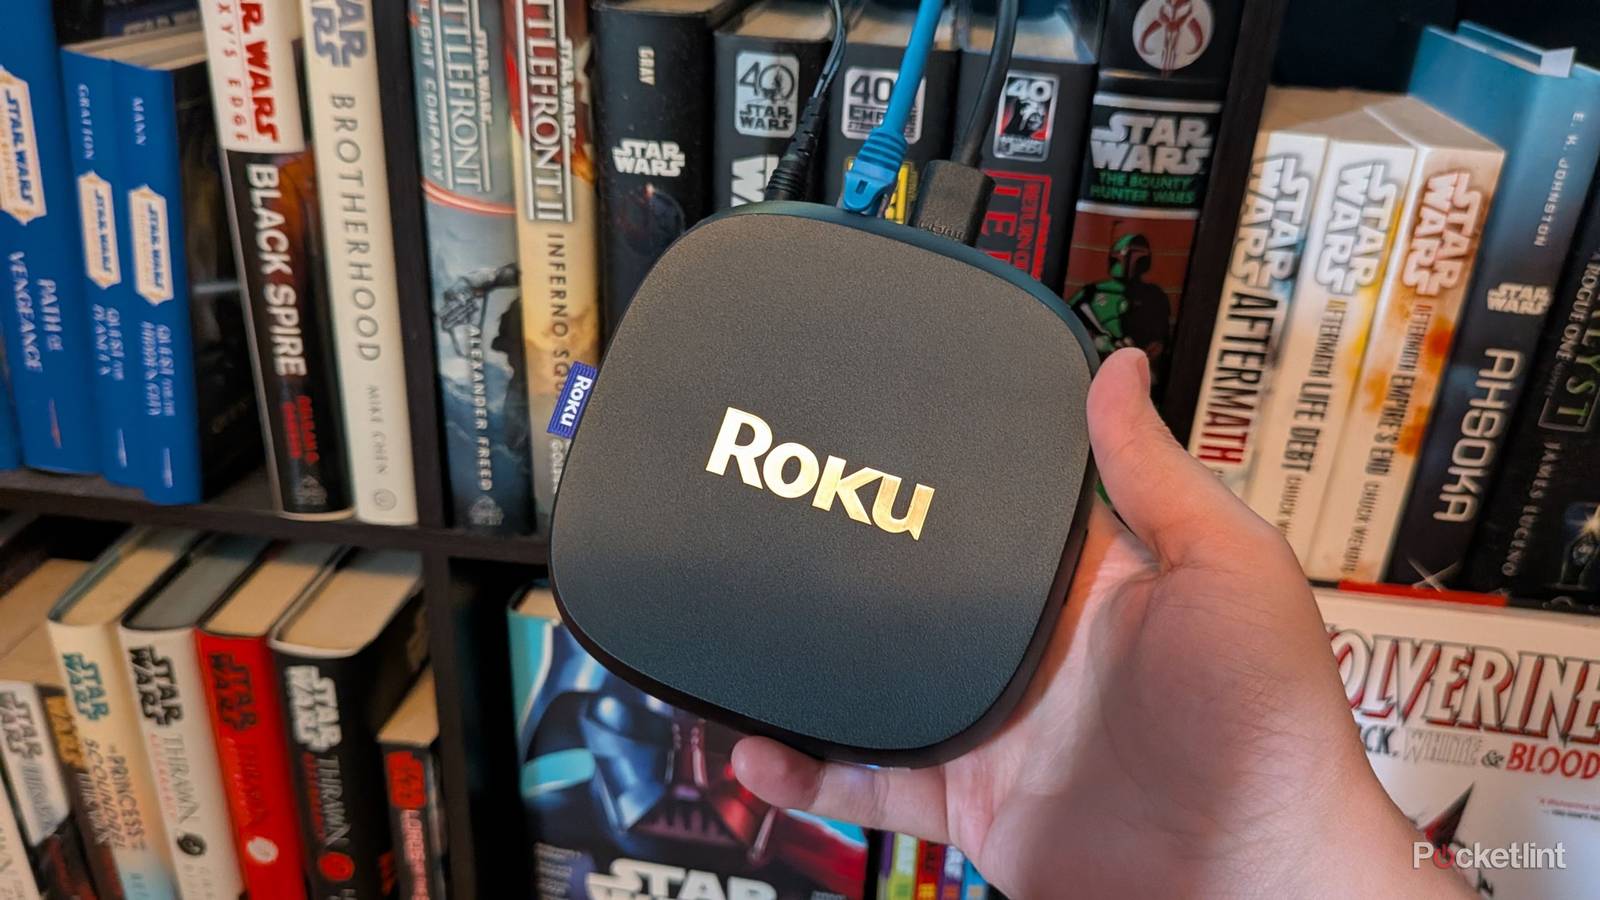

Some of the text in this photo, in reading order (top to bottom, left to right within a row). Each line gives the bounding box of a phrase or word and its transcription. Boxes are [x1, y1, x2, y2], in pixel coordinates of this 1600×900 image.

[308, 0, 343, 68] RS
[334, 0, 368, 68] AR
[638, 46, 656, 85] GRAY
[245, 41, 279, 143] WARS
[417, 0, 446, 182] LIGHT COMPANY
[442, 0, 483, 193] TTLEFRONT
[475, 28, 494, 125] STAR WARS
[526, 0, 564, 194] TTLEFRONT
[560, 38, 578, 140] STAR WARS
[740, 103, 793, 119] STAR
[849, 74, 894, 105] 40
[1005, 79, 1053, 102] 40
[6, 89, 25, 147] STAR
[131, 96, 148, 146] MANN
[612, 139, 686, 162] STAR
[740, 116, 792, 132] WARS
[1089, 139, 1210, 176] WARS
[1092, 112, 1213, 148] STAR
[14, 149, 34, 204] WARS
[613, 157, 686, 177] WARS
[1533, 157, 1571, 248] JOHNSTON
[247, 163, 294, 278] BLACK
[329, 94, 382, 363] BROTHERHOOD
[1230, 157, 1285, 287] WARS
[1262, 155, 1310, 289] STAR
[1315, 163, 1373, 293] WARS
[1345, 161, 1398, 295] STAR
[1402, 171, 1460, 291] WARS
[1430, 171, 1482, 297] STAR
[9, 250, 42, 372] VENGEANCE
[546, 232, 570, 339] INFERNO
[1486, 297, 1548, 316] WARS
[1488, 282, 1551, 303] STAR
[1569, 262, 1600, 322] ROGUE
[262, 283, 308, 378] SPIRE
[1310, 298, 1349, 379] AFTERMATH
[1397, 302, 1434, 373] AFTERMATH
[1554, 322, 1583, 361] ONE
[466, 326, 494, 492] ALEXANDER FREED
[1197, 290, 1279, 465] AFTERMATH
[1293, 381, 1334, 422] LIFE
[1373, 373, 1417, 443] EMPIRE'S
[364, 383, 389, 477] MIKE CHEN
[1280, 425, 1323, 473] DEBT
[1364, 445, 1397, 476] END
[1433, 347, 1523, 523] AHSOKA
[1501, 440, 1561, 578] JAMES LUCENO
[61, 652, 93, 718] WARS
[79, 652, 110, 721] STAR
[128, 646, 165, 724] WARS
[146, 645, 183, 727] STAR
[208, 653, 244, 728] WARS
[228, 653, 258, 732] STAR
[285, 665, 326, 747] WARS
[309, 664, 342, 752] STAR
[1331, 627, 1600, 746] OLVERINE
[1361, 726, 1400, 758] CK,
[1480, 748, 1504, 769] &
[1505, 741, 1600, 780] BLOOD
[317, 747, 352, 846] THRAWN
